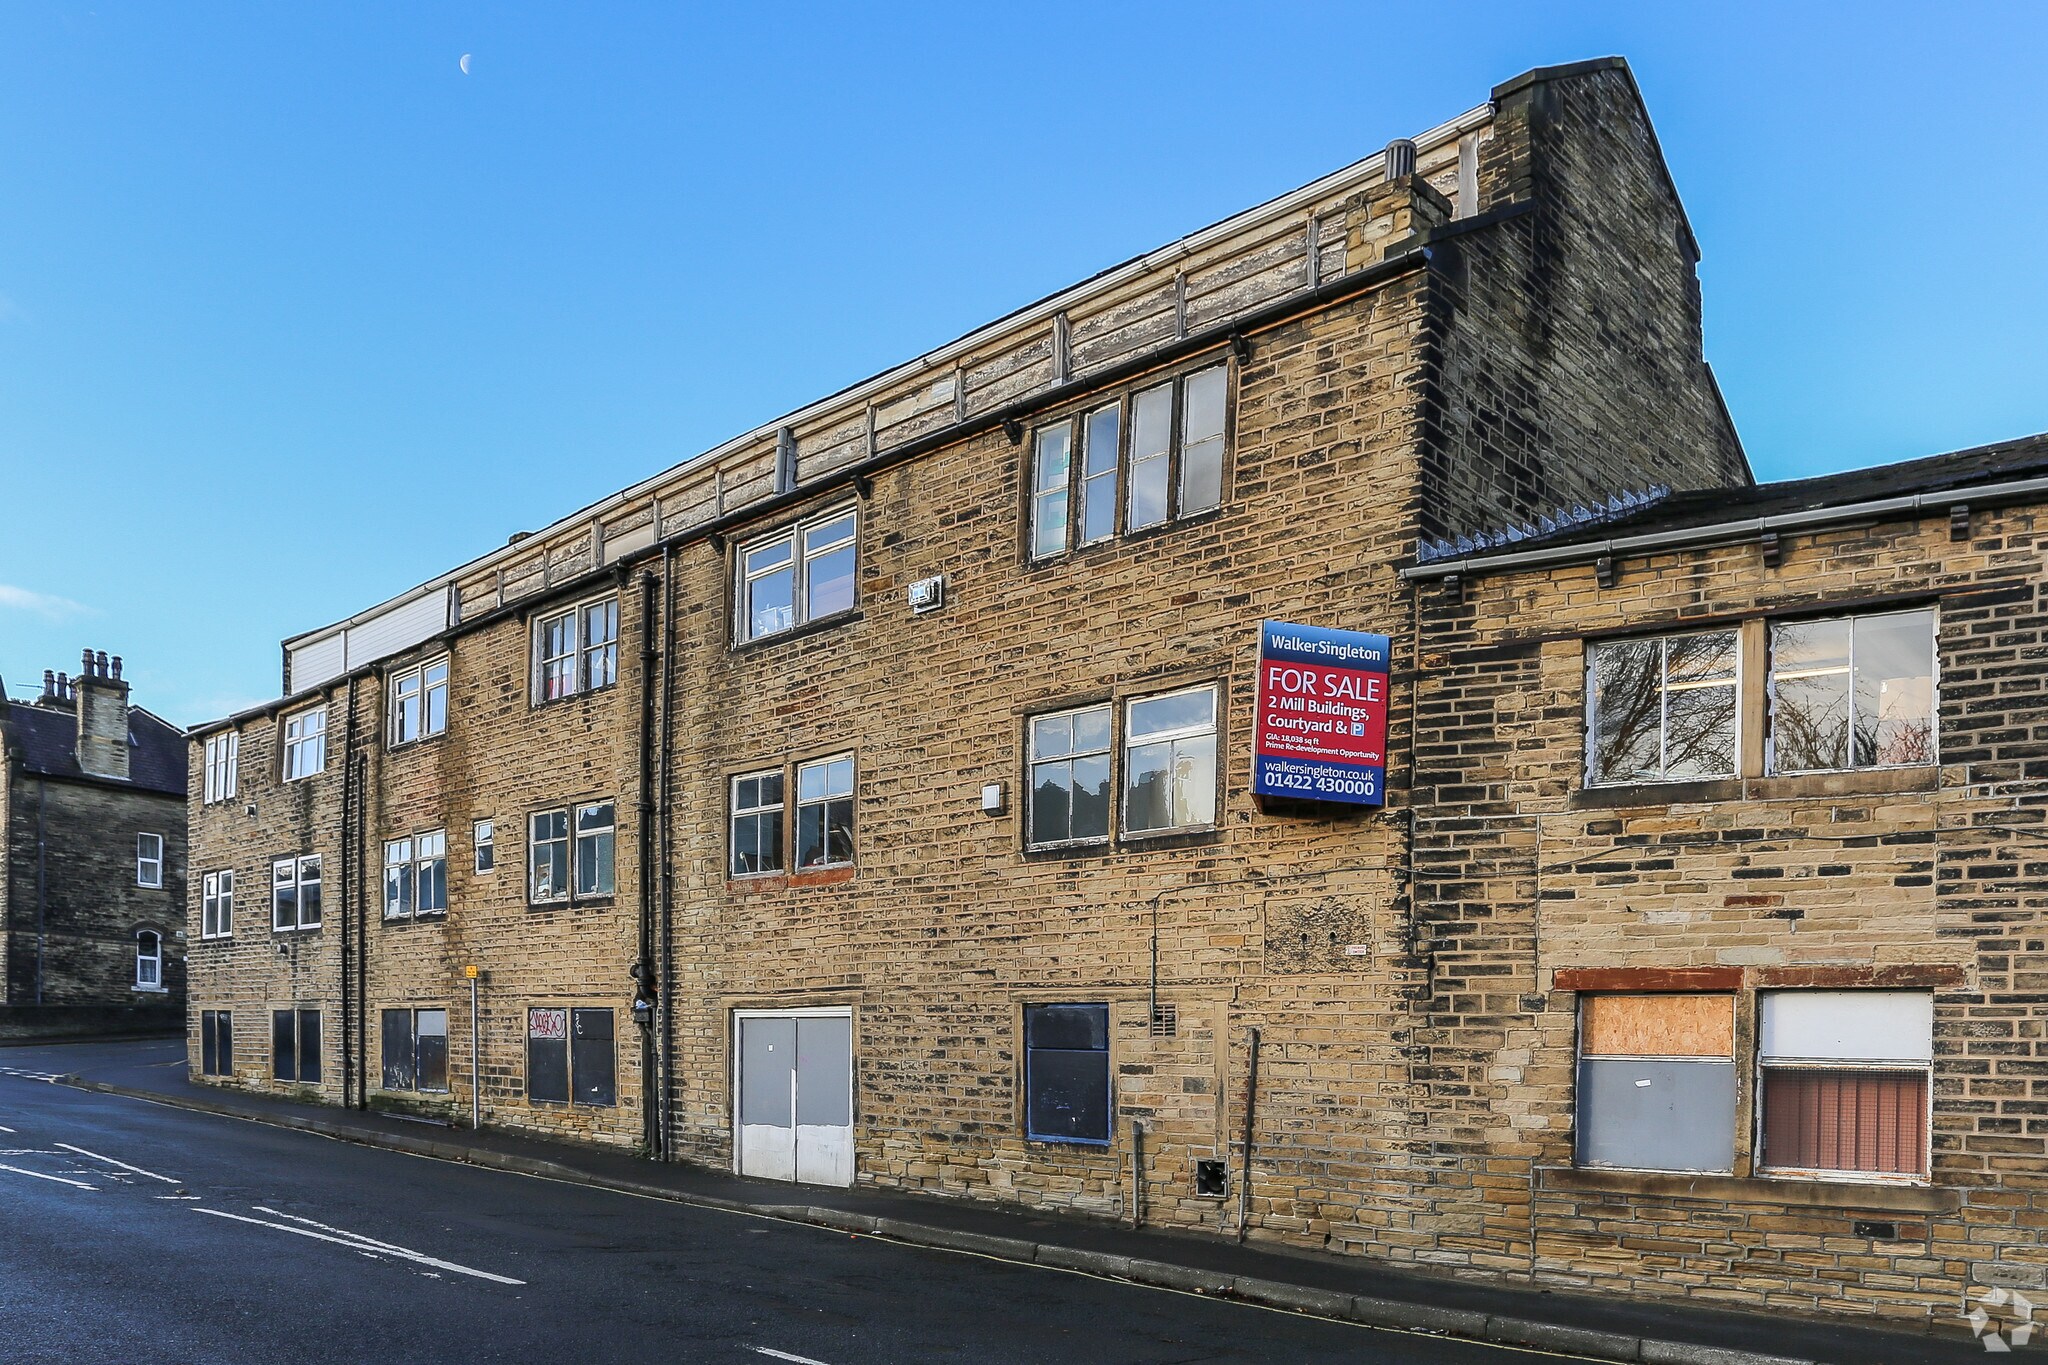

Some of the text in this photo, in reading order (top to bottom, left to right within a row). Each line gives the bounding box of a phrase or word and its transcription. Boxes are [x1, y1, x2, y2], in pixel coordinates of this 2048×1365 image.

[1271, 634, 1381, 661] WalkerSingleton
[1268, 667, 1380, 702] FOR SALE
[1268, 695, 1370, 721] 2 Mill Buildings,
[1267, 713, 1332, 734] Courtyard
[1335, 720, 1348, 735] &
[1265, 732, 1319, 746] GIA: 18,038 sq ft
[1265, 741, 1380, 760] Prime Re-development Opportunity
[1265, 760, 1375, 782] walkersingleton.co.uk
[1265, 772, 1375, 796] 01422 430000
